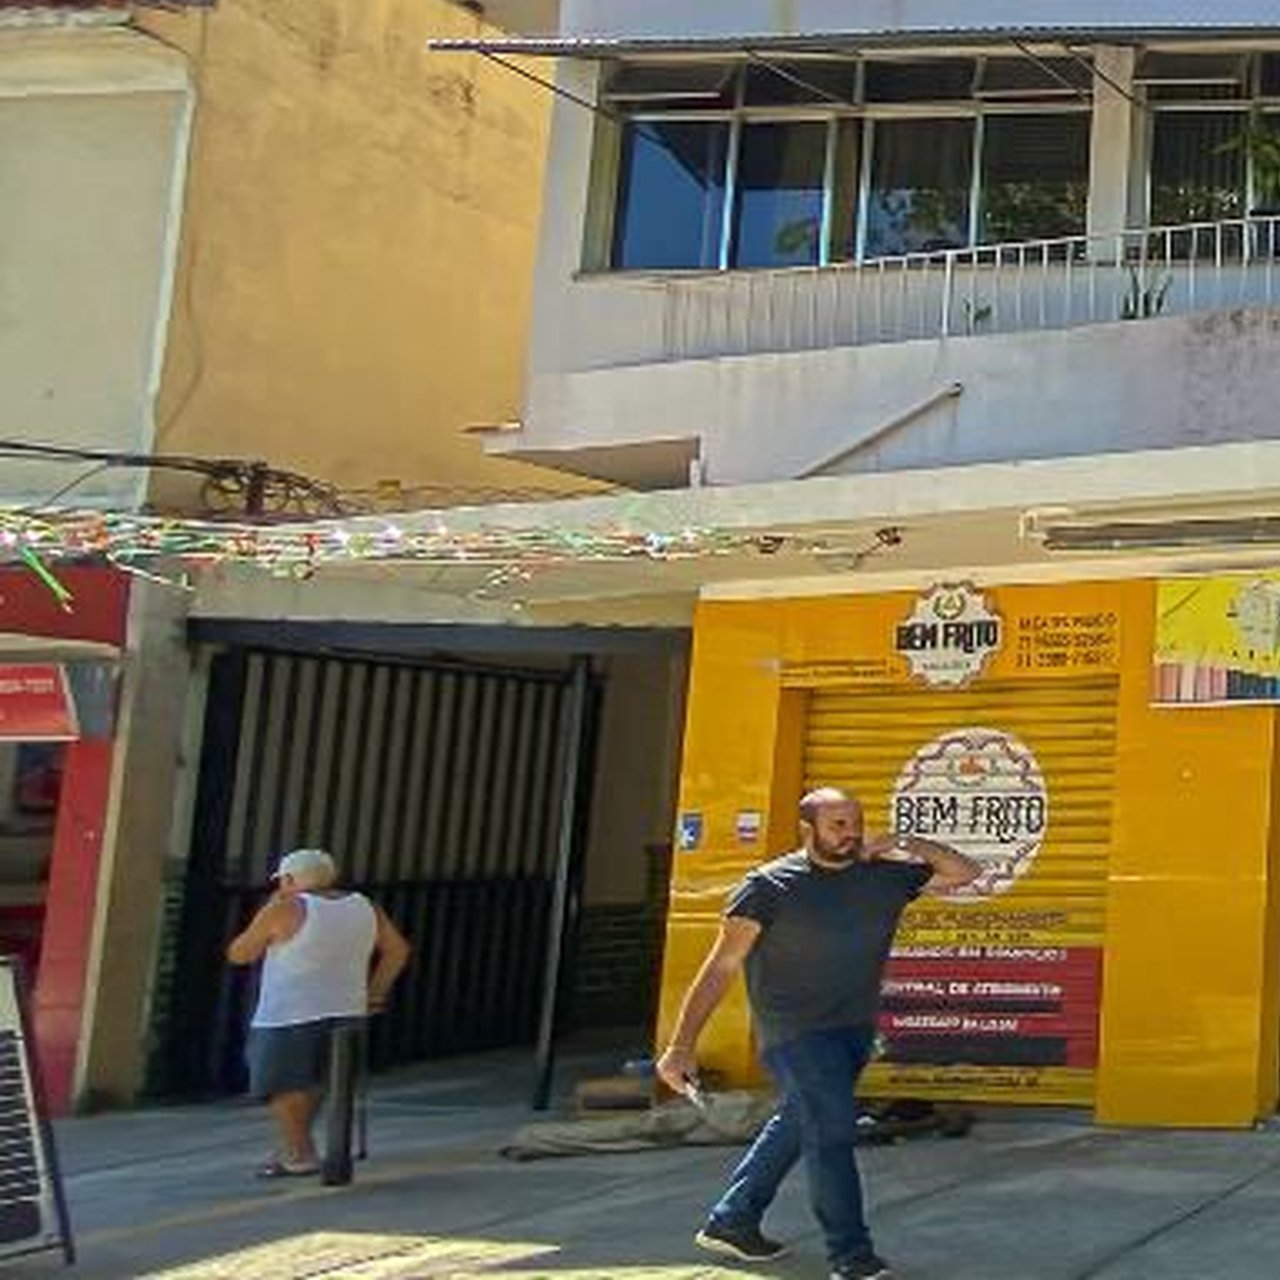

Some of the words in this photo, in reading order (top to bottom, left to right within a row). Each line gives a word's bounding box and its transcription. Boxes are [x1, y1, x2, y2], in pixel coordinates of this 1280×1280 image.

[896, 622, 938, 651] BEM
[942, 619, 998, 653] FRITO
[896, 796, 957, 834] BEM
[970, 796, 1044, 843] FRITO
